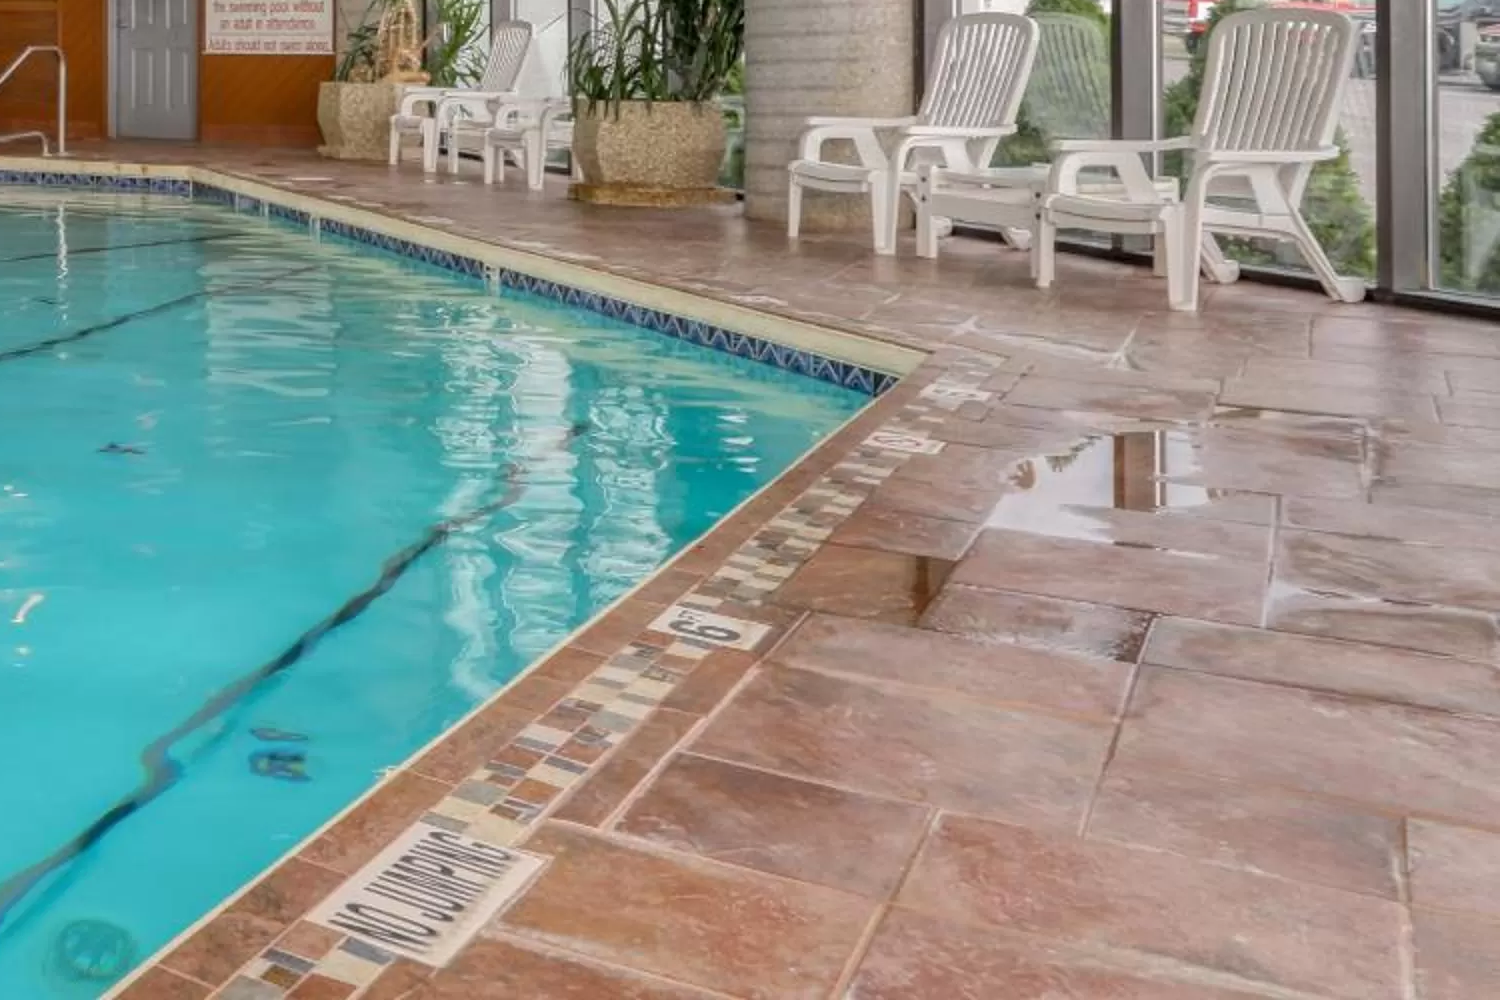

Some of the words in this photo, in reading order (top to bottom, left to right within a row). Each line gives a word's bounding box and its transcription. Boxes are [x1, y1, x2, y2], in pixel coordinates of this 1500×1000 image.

[668, 620, 741, 642] 6
[363, 831, 511, 922] JUMPING
[327, 902, 437, 954] NO
